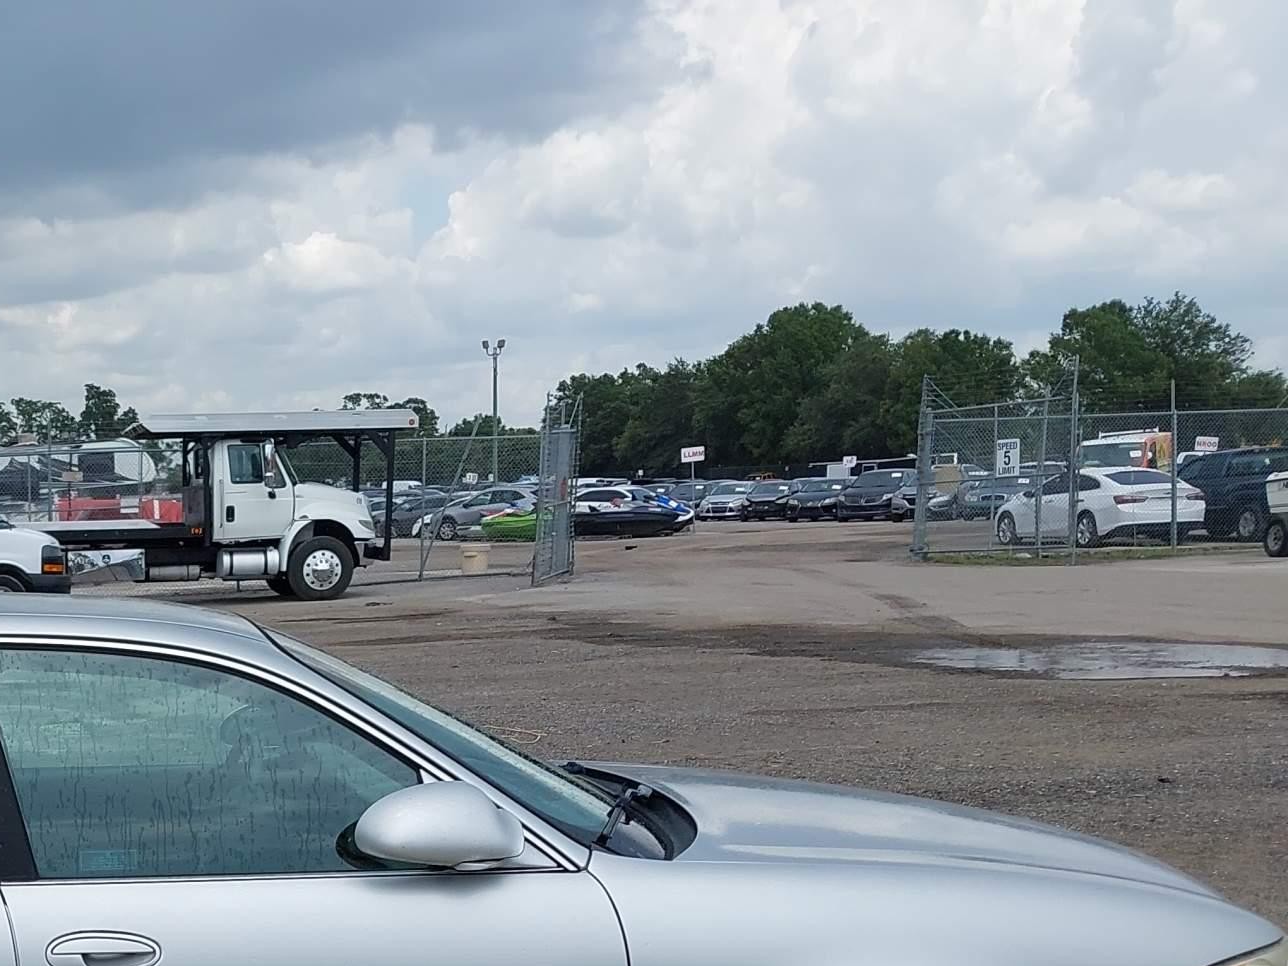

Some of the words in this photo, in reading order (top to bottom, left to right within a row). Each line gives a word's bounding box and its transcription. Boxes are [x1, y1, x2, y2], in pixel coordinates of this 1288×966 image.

[997, 441, 1017, 451] SPEED
[1003, 450, 1011, 466] 5
[998, 466, 1016, 475] LIMIT
